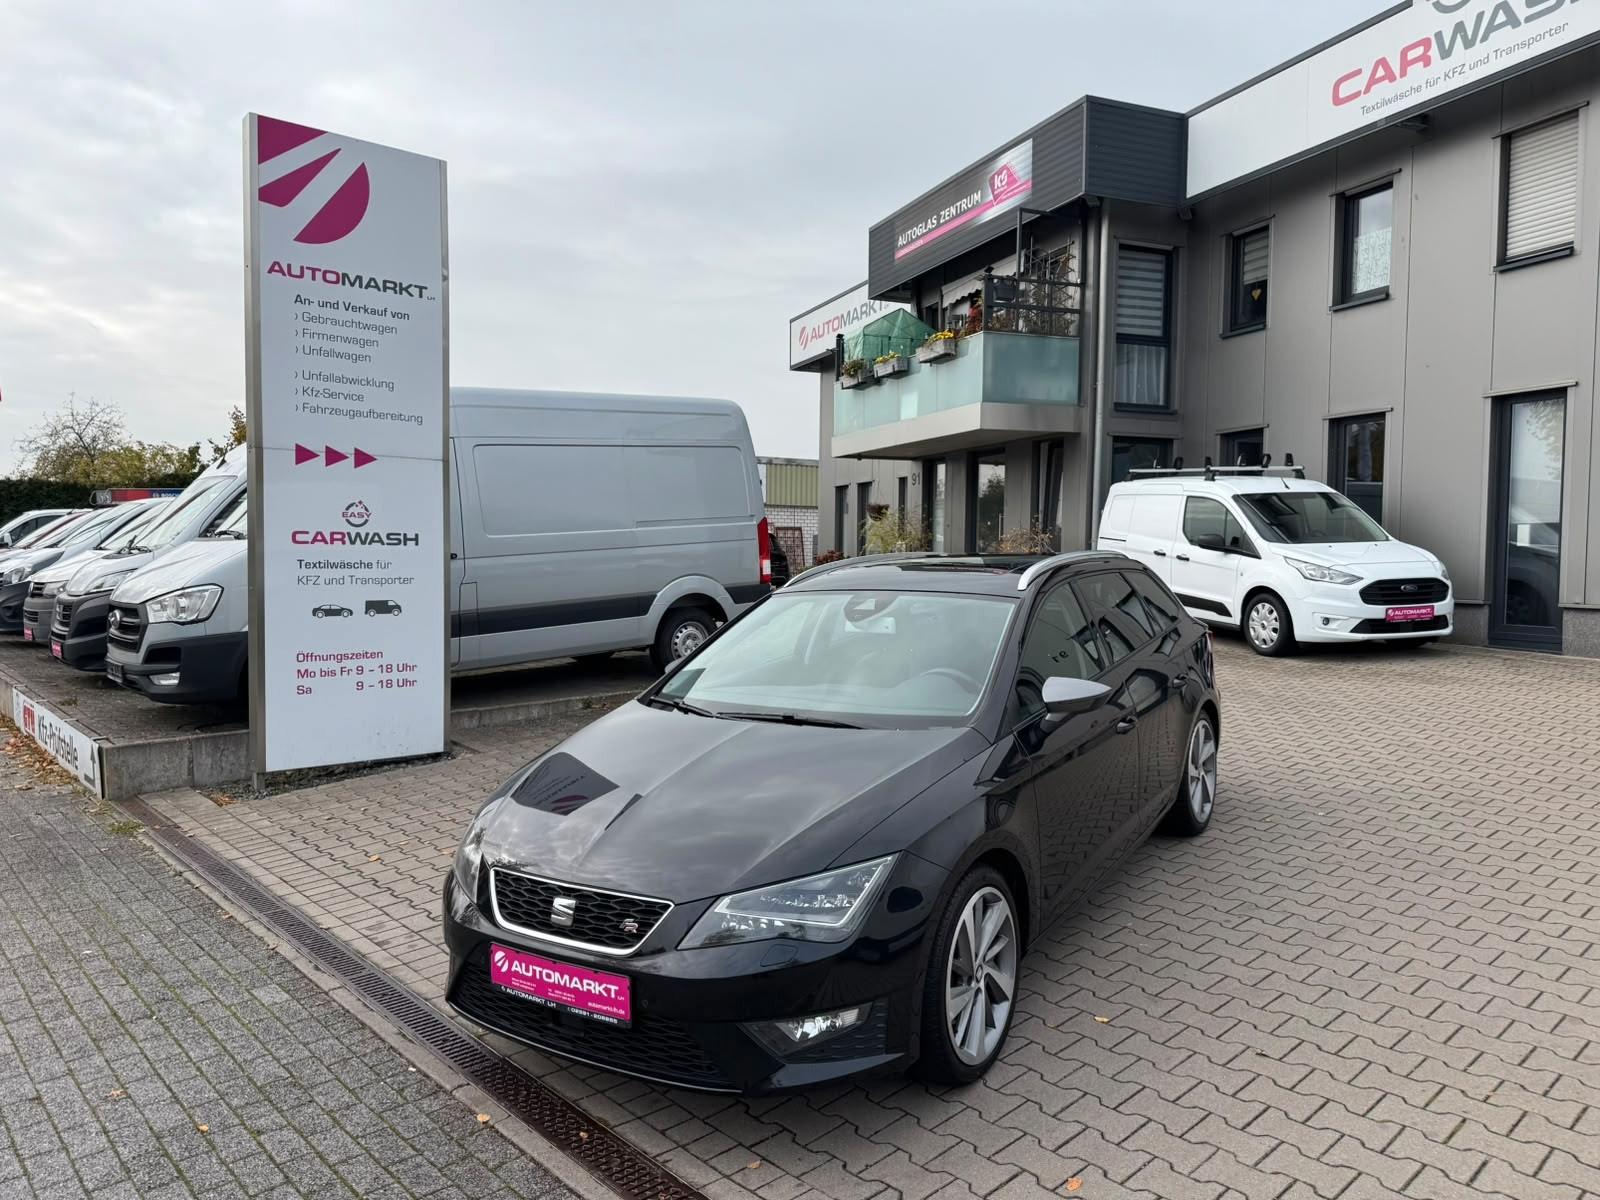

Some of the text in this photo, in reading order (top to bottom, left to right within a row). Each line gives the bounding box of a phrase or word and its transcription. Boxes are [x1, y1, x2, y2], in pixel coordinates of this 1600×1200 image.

[1331, 0, 1592, 107] CARWA
[1360, 22, 1569, 116] Textilwäsche für KFZ und Transporter
[897, 190, 981, 247] AUTOGLAS ZENTRUM
[267, 261, 428, 299] AUTOMARKT
[294, 294, 410, 320] An- und Verkauf von
[302, 311, 398, 335] Gebrauchtwagen
[810, 300, 883, 342] AUTOMARKT
[302, 328, 379, 348] Firmenwagen
[302, 345, 372, 363] Unfallwagen
[302, 369, 395, 392] Unfallabwicklung
[302, 386, 365, 402] Kfz-Service
[302, 402, 423, 425] Fahrzeugaufbereitung
[911, 472, 921, 486] 91
[342, 511, 373, 519] EASY
[291, 530, 420, 546] CARWASH
[297, 559, 393, 570] Textilwäsche für
[297, 575, 415, 587] KFZ und Transporter
[296, 650, 384, 663] Öffnungszeiten
[297, 668, 316, 679] Mo
[319, 667, 337, 678] bis
[340, 666, 353, 677] Fr
[356, 665, 364, 676] 9
[378, 664, 393, 674] 18
[396, 663, 418, 673] Uhr
[296, 685, 312, 695] Sa
[356, 681, 364, 691] 9
[378, 679, 393, 689] 18
[396, 678, 418, 688] Uhr
[37, 714, 79, 771] Kfz-Prüfstelle
[511, 960, 619, 999] AUTOMARKT
[506, 988, 546, 1005] AUTOMARKT
[547, 1000, 557, 1009] LH
